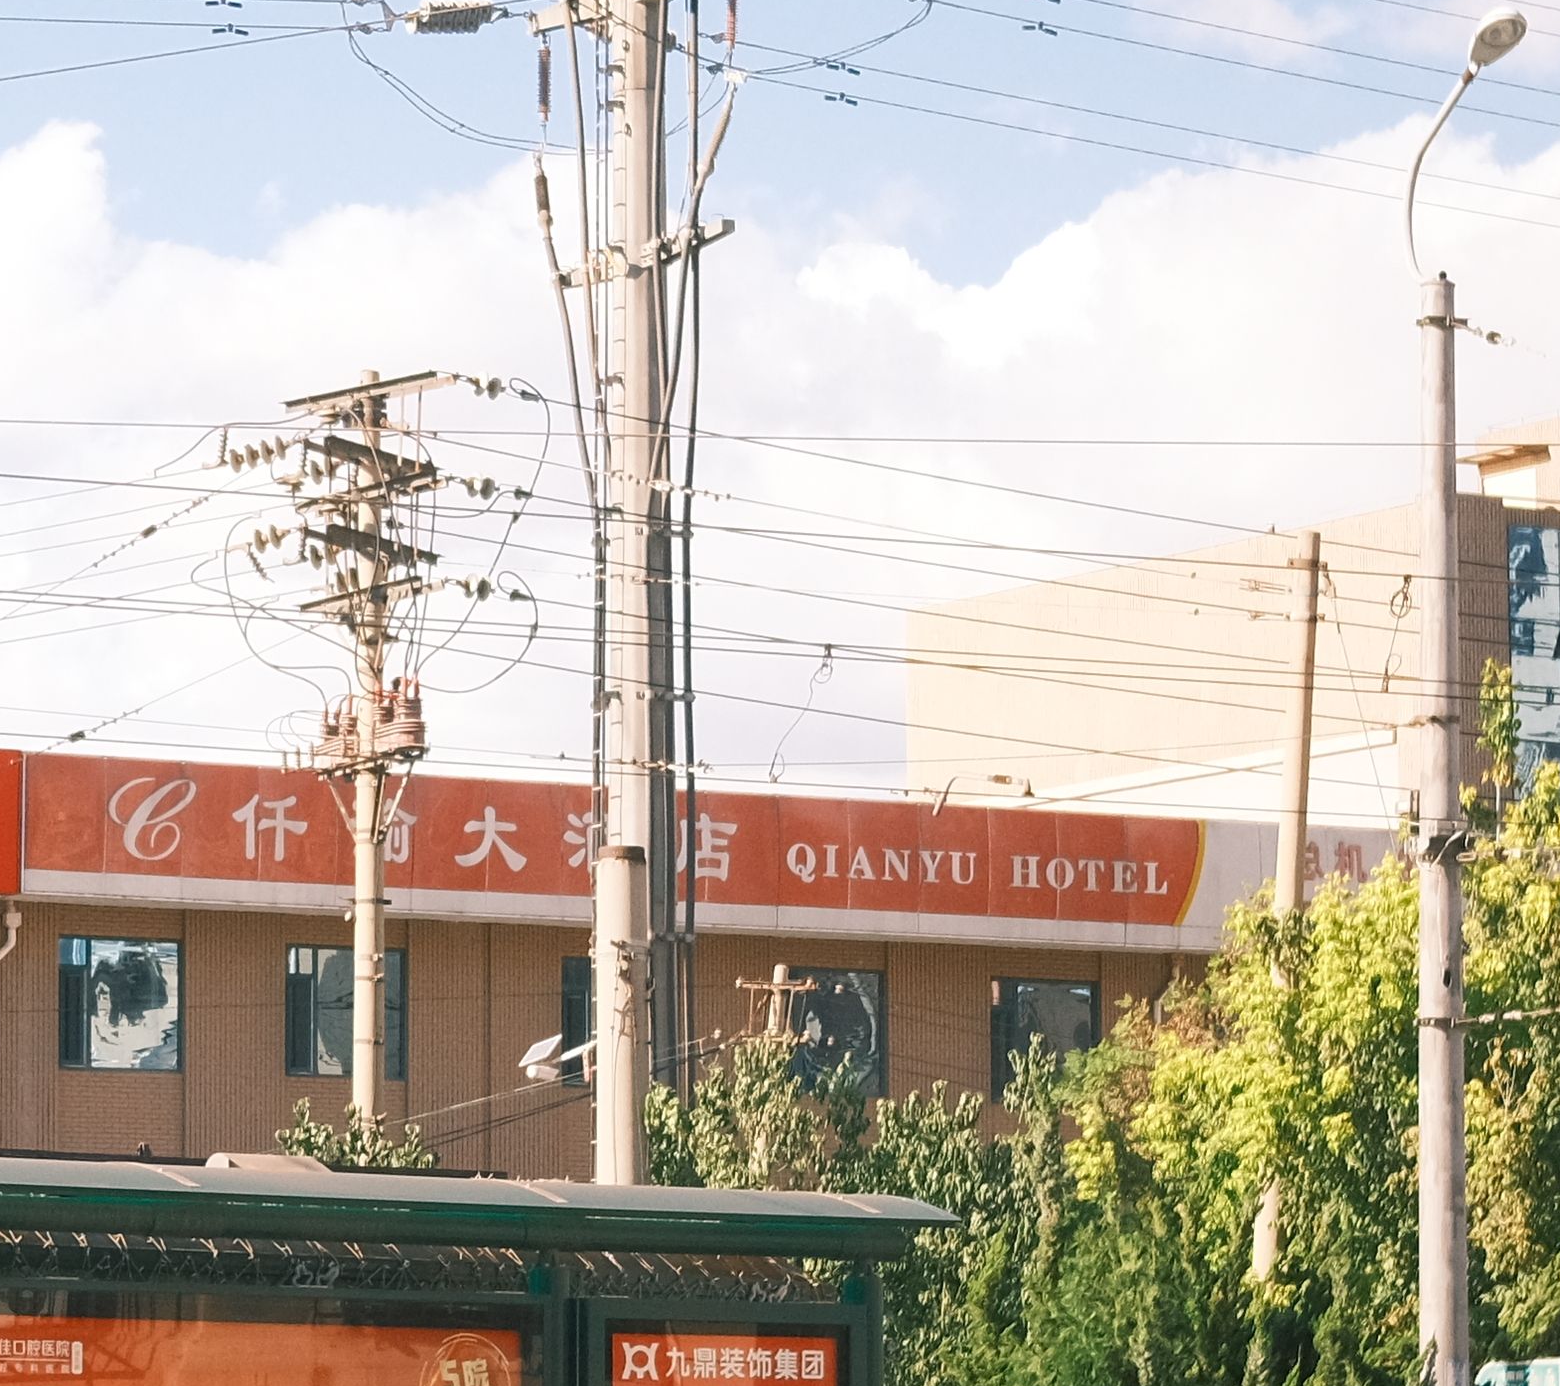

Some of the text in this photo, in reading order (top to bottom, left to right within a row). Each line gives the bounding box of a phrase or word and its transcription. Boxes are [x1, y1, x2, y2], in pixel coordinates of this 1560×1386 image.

[786, 842, 977, 885] QIANYU
[1010, 854, 1168, 896] HOTEL
[665, 1346, 825, 1381] 九鼎装饰集团
